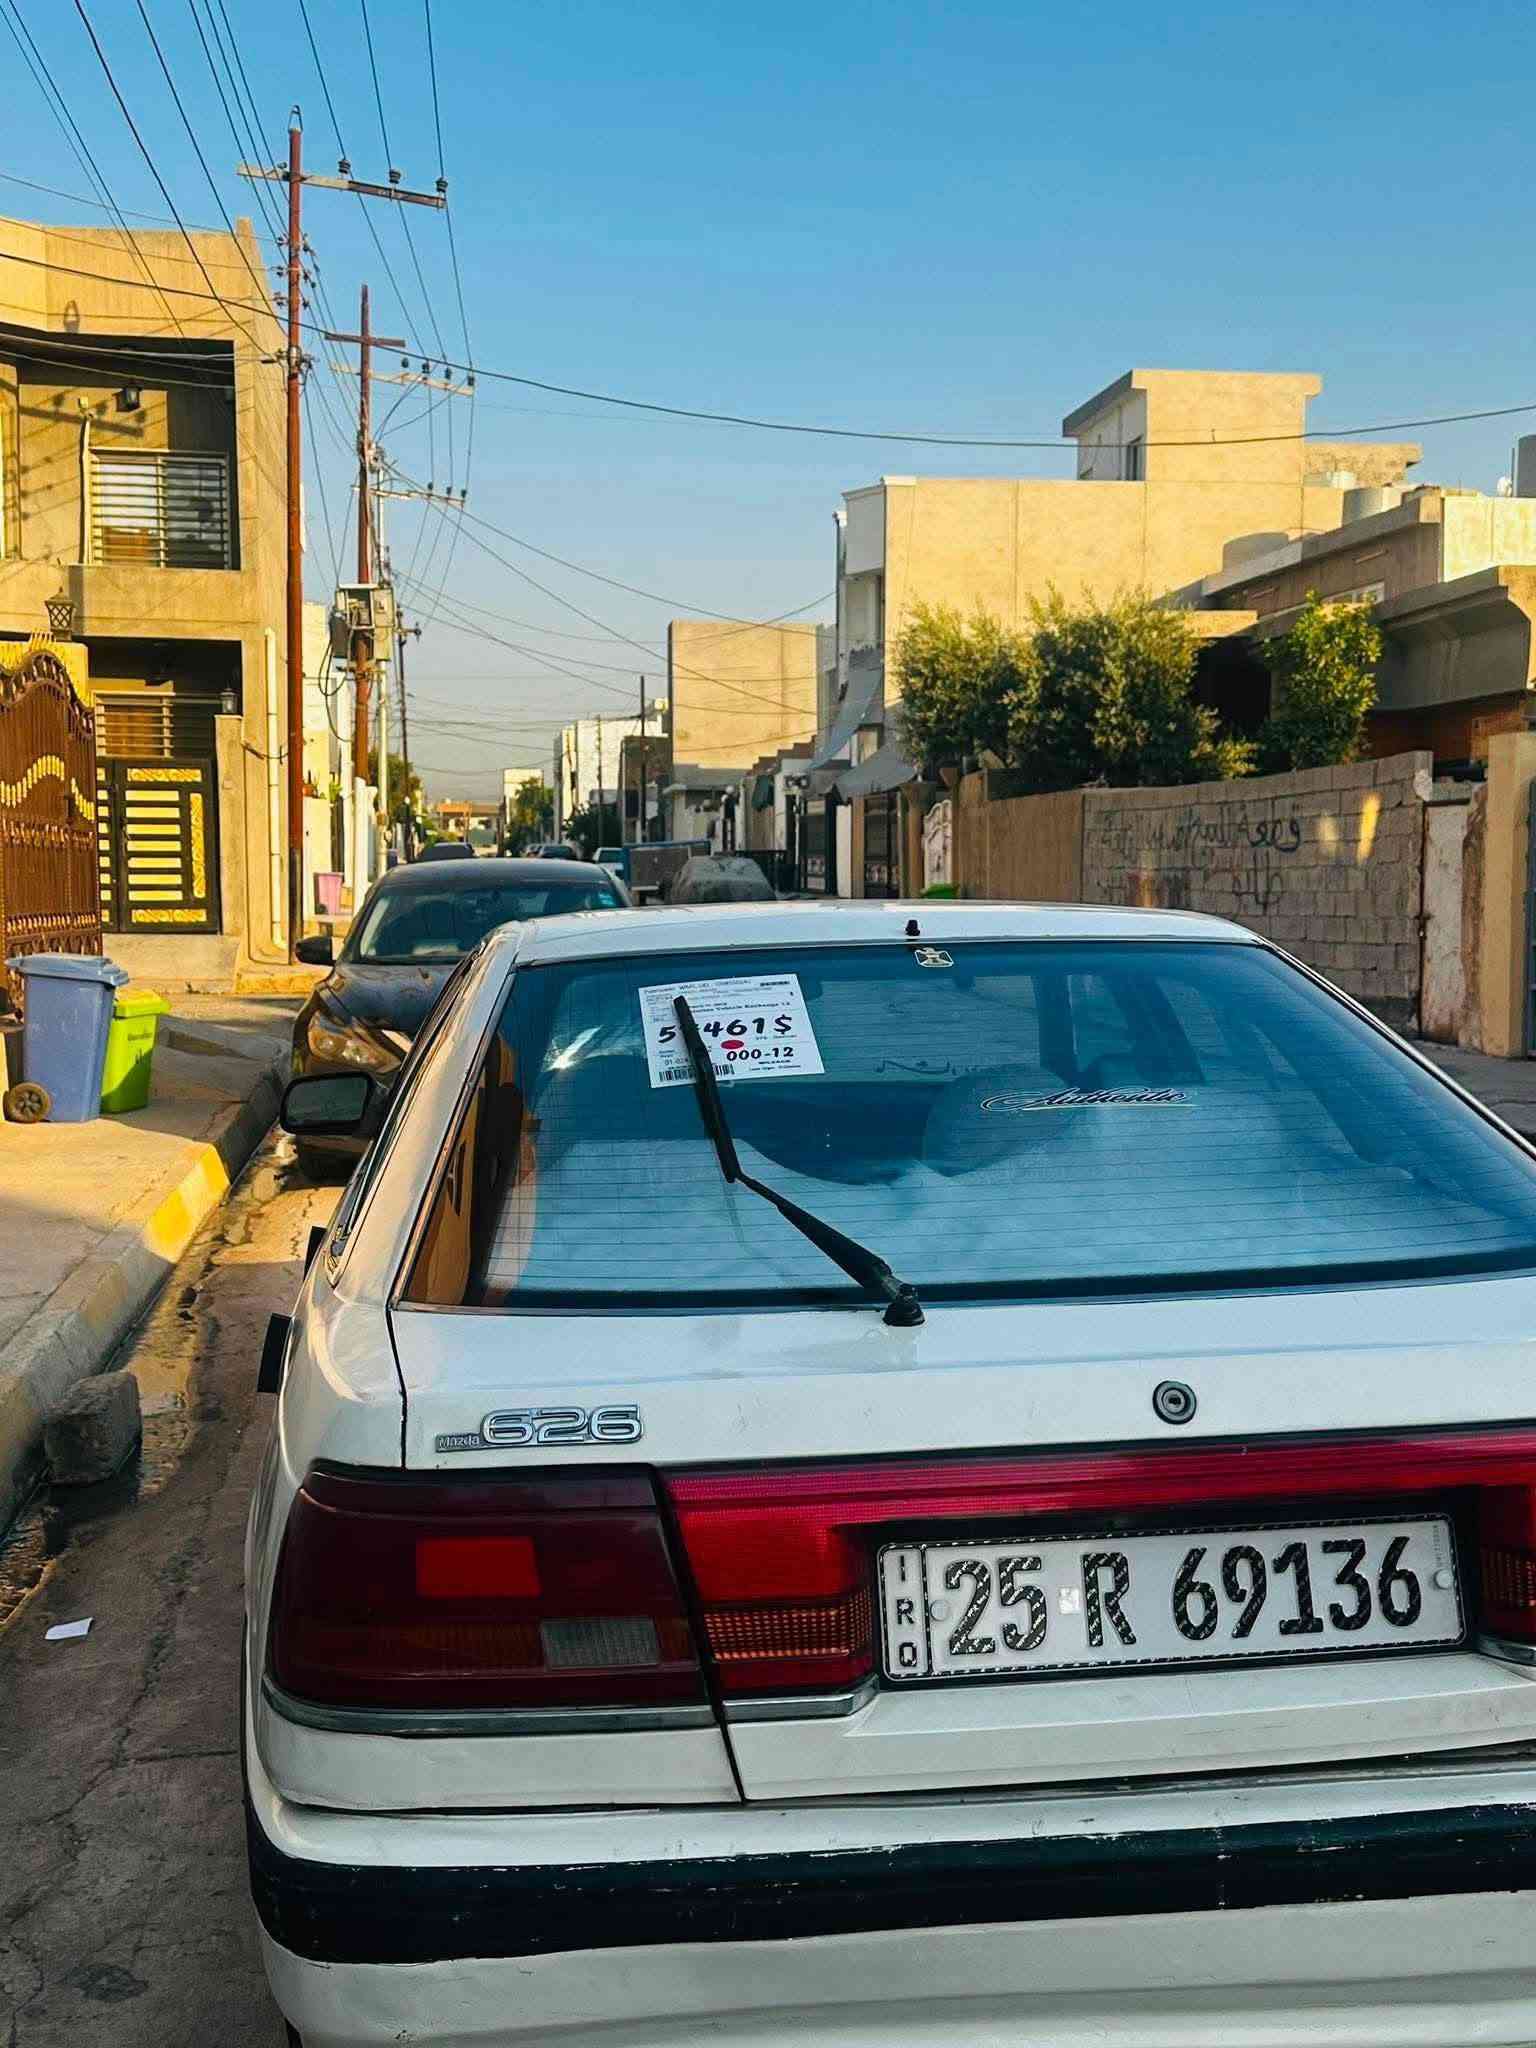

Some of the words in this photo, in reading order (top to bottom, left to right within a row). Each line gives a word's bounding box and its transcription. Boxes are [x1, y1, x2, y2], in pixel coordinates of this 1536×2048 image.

[658, 1014, 793, 1044] 5461$
[438, 1435, 480, 1448] Mazda
[480, 1404, 643, 1446] 626
[897, 1555, 918, 1668] IRQ
[944, 1555, 1048, 1656] 25
[1082, 1551, 1136, 1647] R
[1171, 1535, 1422, 1641] 69136
